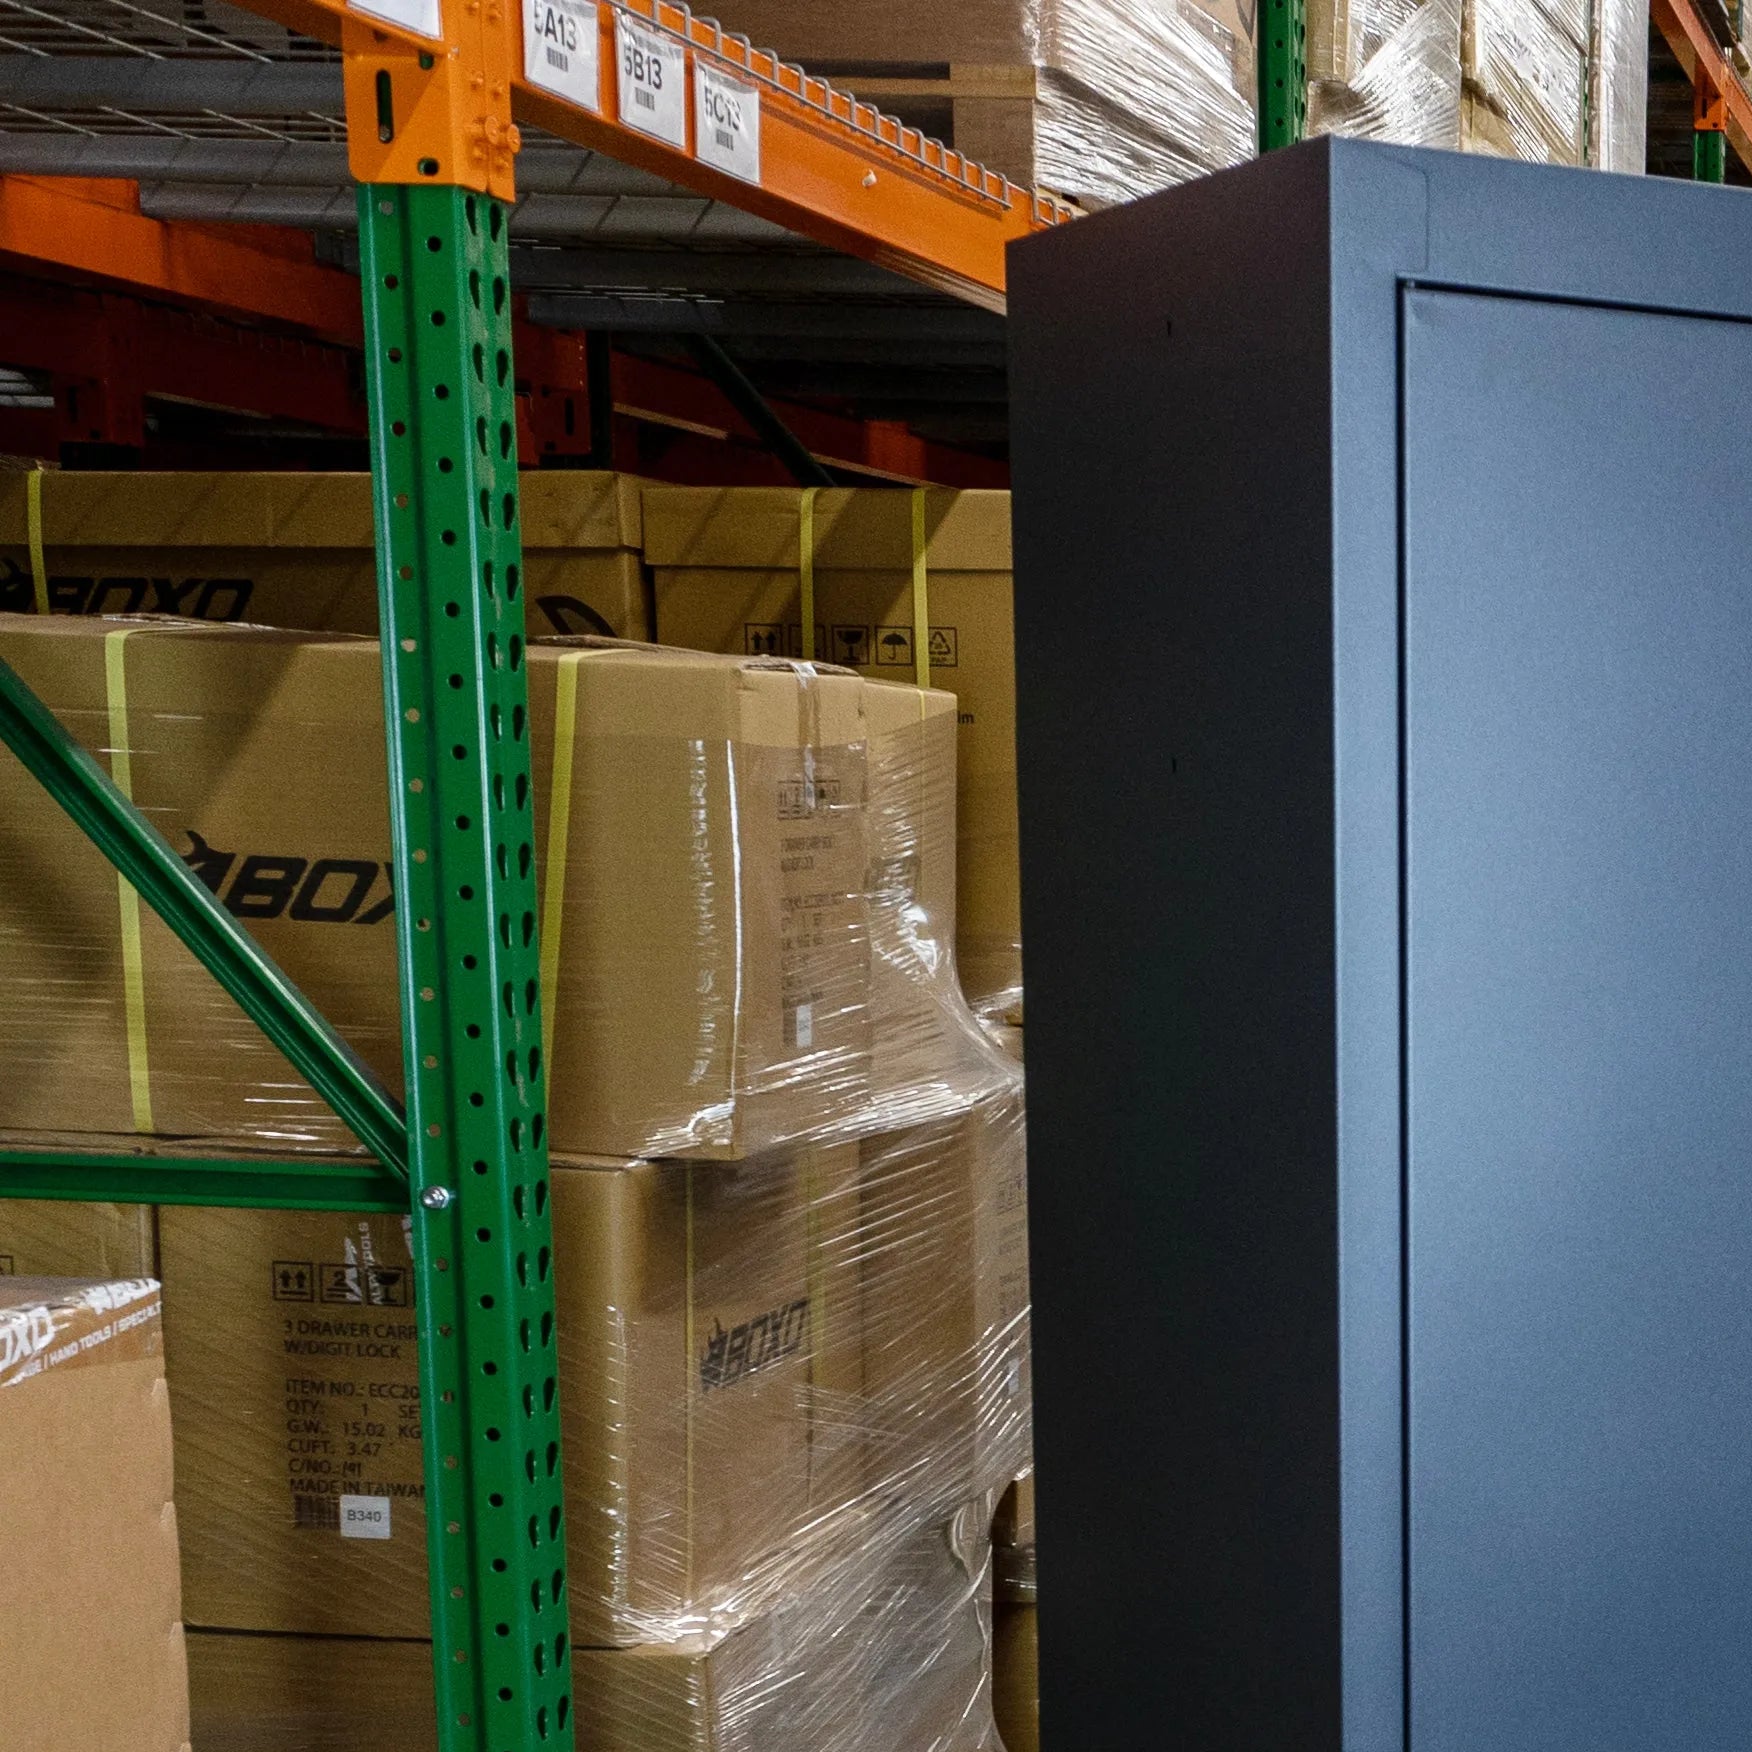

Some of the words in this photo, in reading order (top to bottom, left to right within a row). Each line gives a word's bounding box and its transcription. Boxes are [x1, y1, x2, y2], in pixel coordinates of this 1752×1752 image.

[534, 2, 578, 51] 5A13
[624, 45, 663, 89] 5B13
[47, 576, 255, 623] BOXO
[222, 855, 396, 924] BOX
[284, 1319, 293, 1335] 3
[297, 1320, 371, 1338] DRAWER
[374, 1323, 418, 1341] CARR
[49, 1341, 79, 1367] HAND
[79, 1325, 112, 1350] TOOLS
[356, 1343, 401, 1360] LOCK
[285, 1378, 326, 1396] ITEM
[368, 1382, 420, 1400] ECC20
[398, 1404, 421, 1420] SE
[342, 1421, 386, 1438] 15.02
[398, 1424, 421, 1440] KG
[345, 1441, 382, 1458] 3.47
[289, 1478, 340, 1494] MADE
[342, 1480, 361, 1495] IN
[346, 1509, 383, 1523] B340
